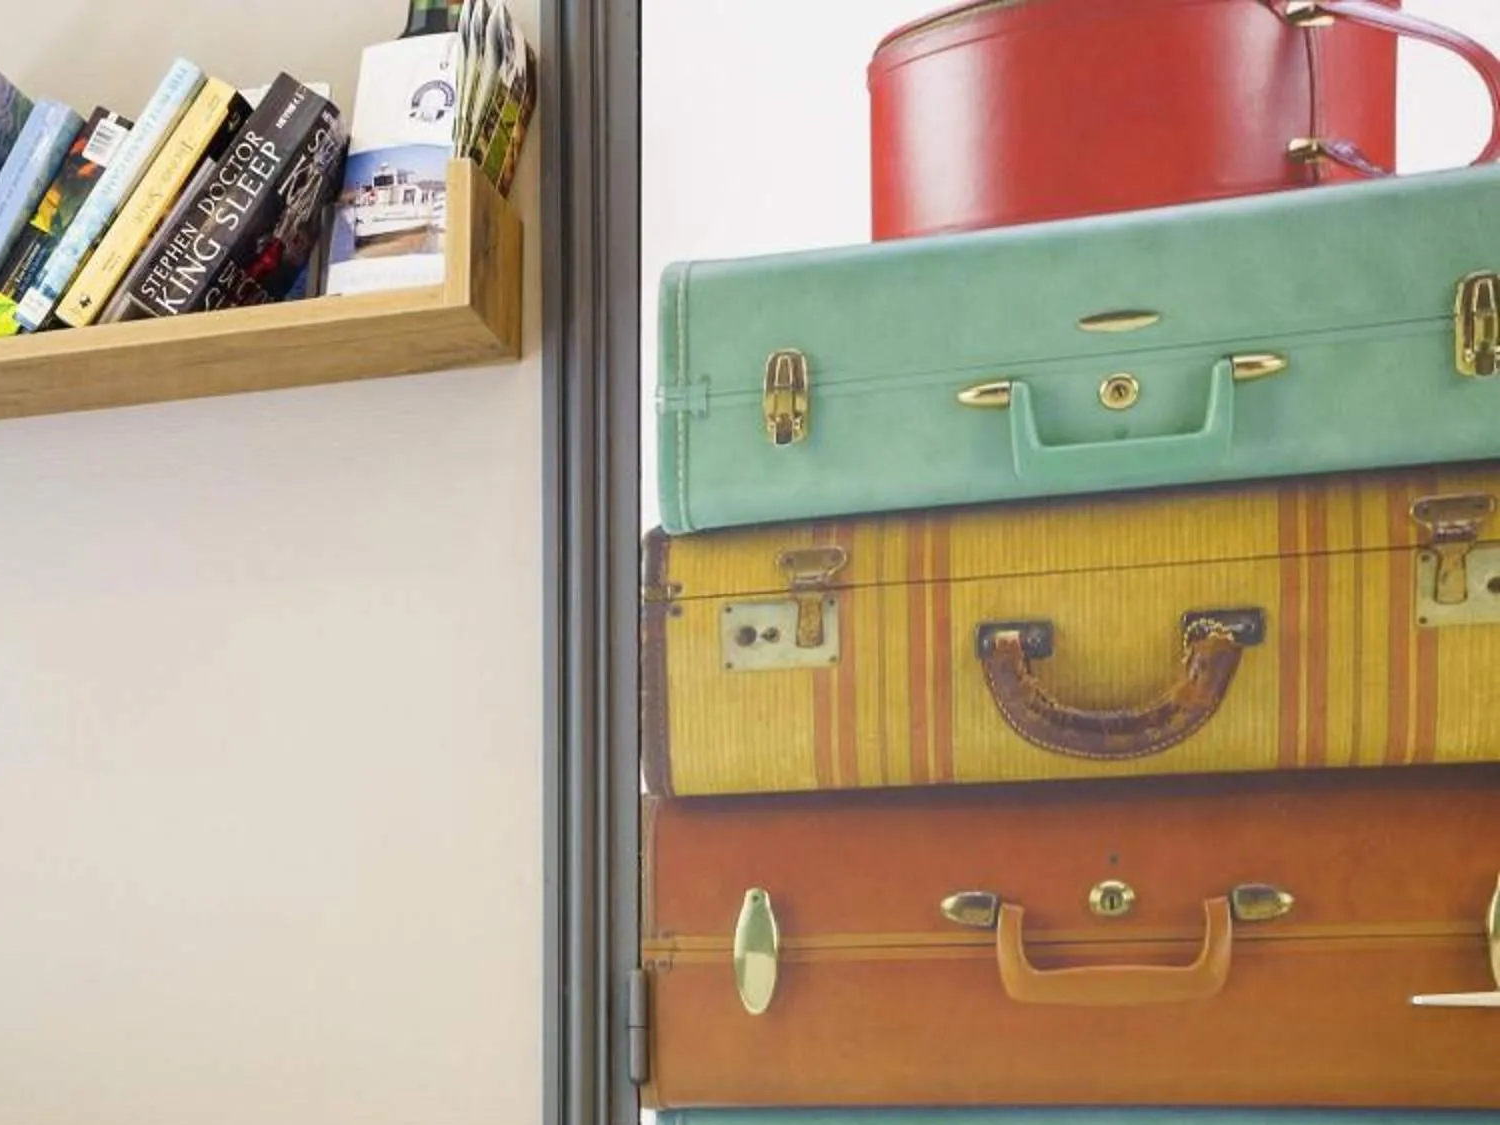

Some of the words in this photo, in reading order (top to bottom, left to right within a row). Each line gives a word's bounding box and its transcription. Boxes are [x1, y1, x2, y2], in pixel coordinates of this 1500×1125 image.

[140, 220, 200, 298] STEPHEN
[197, 129, 264, 215] DOCTOR
[155, 232, 222, 315] KING
[214, 140, 284, 231] SLEEP
